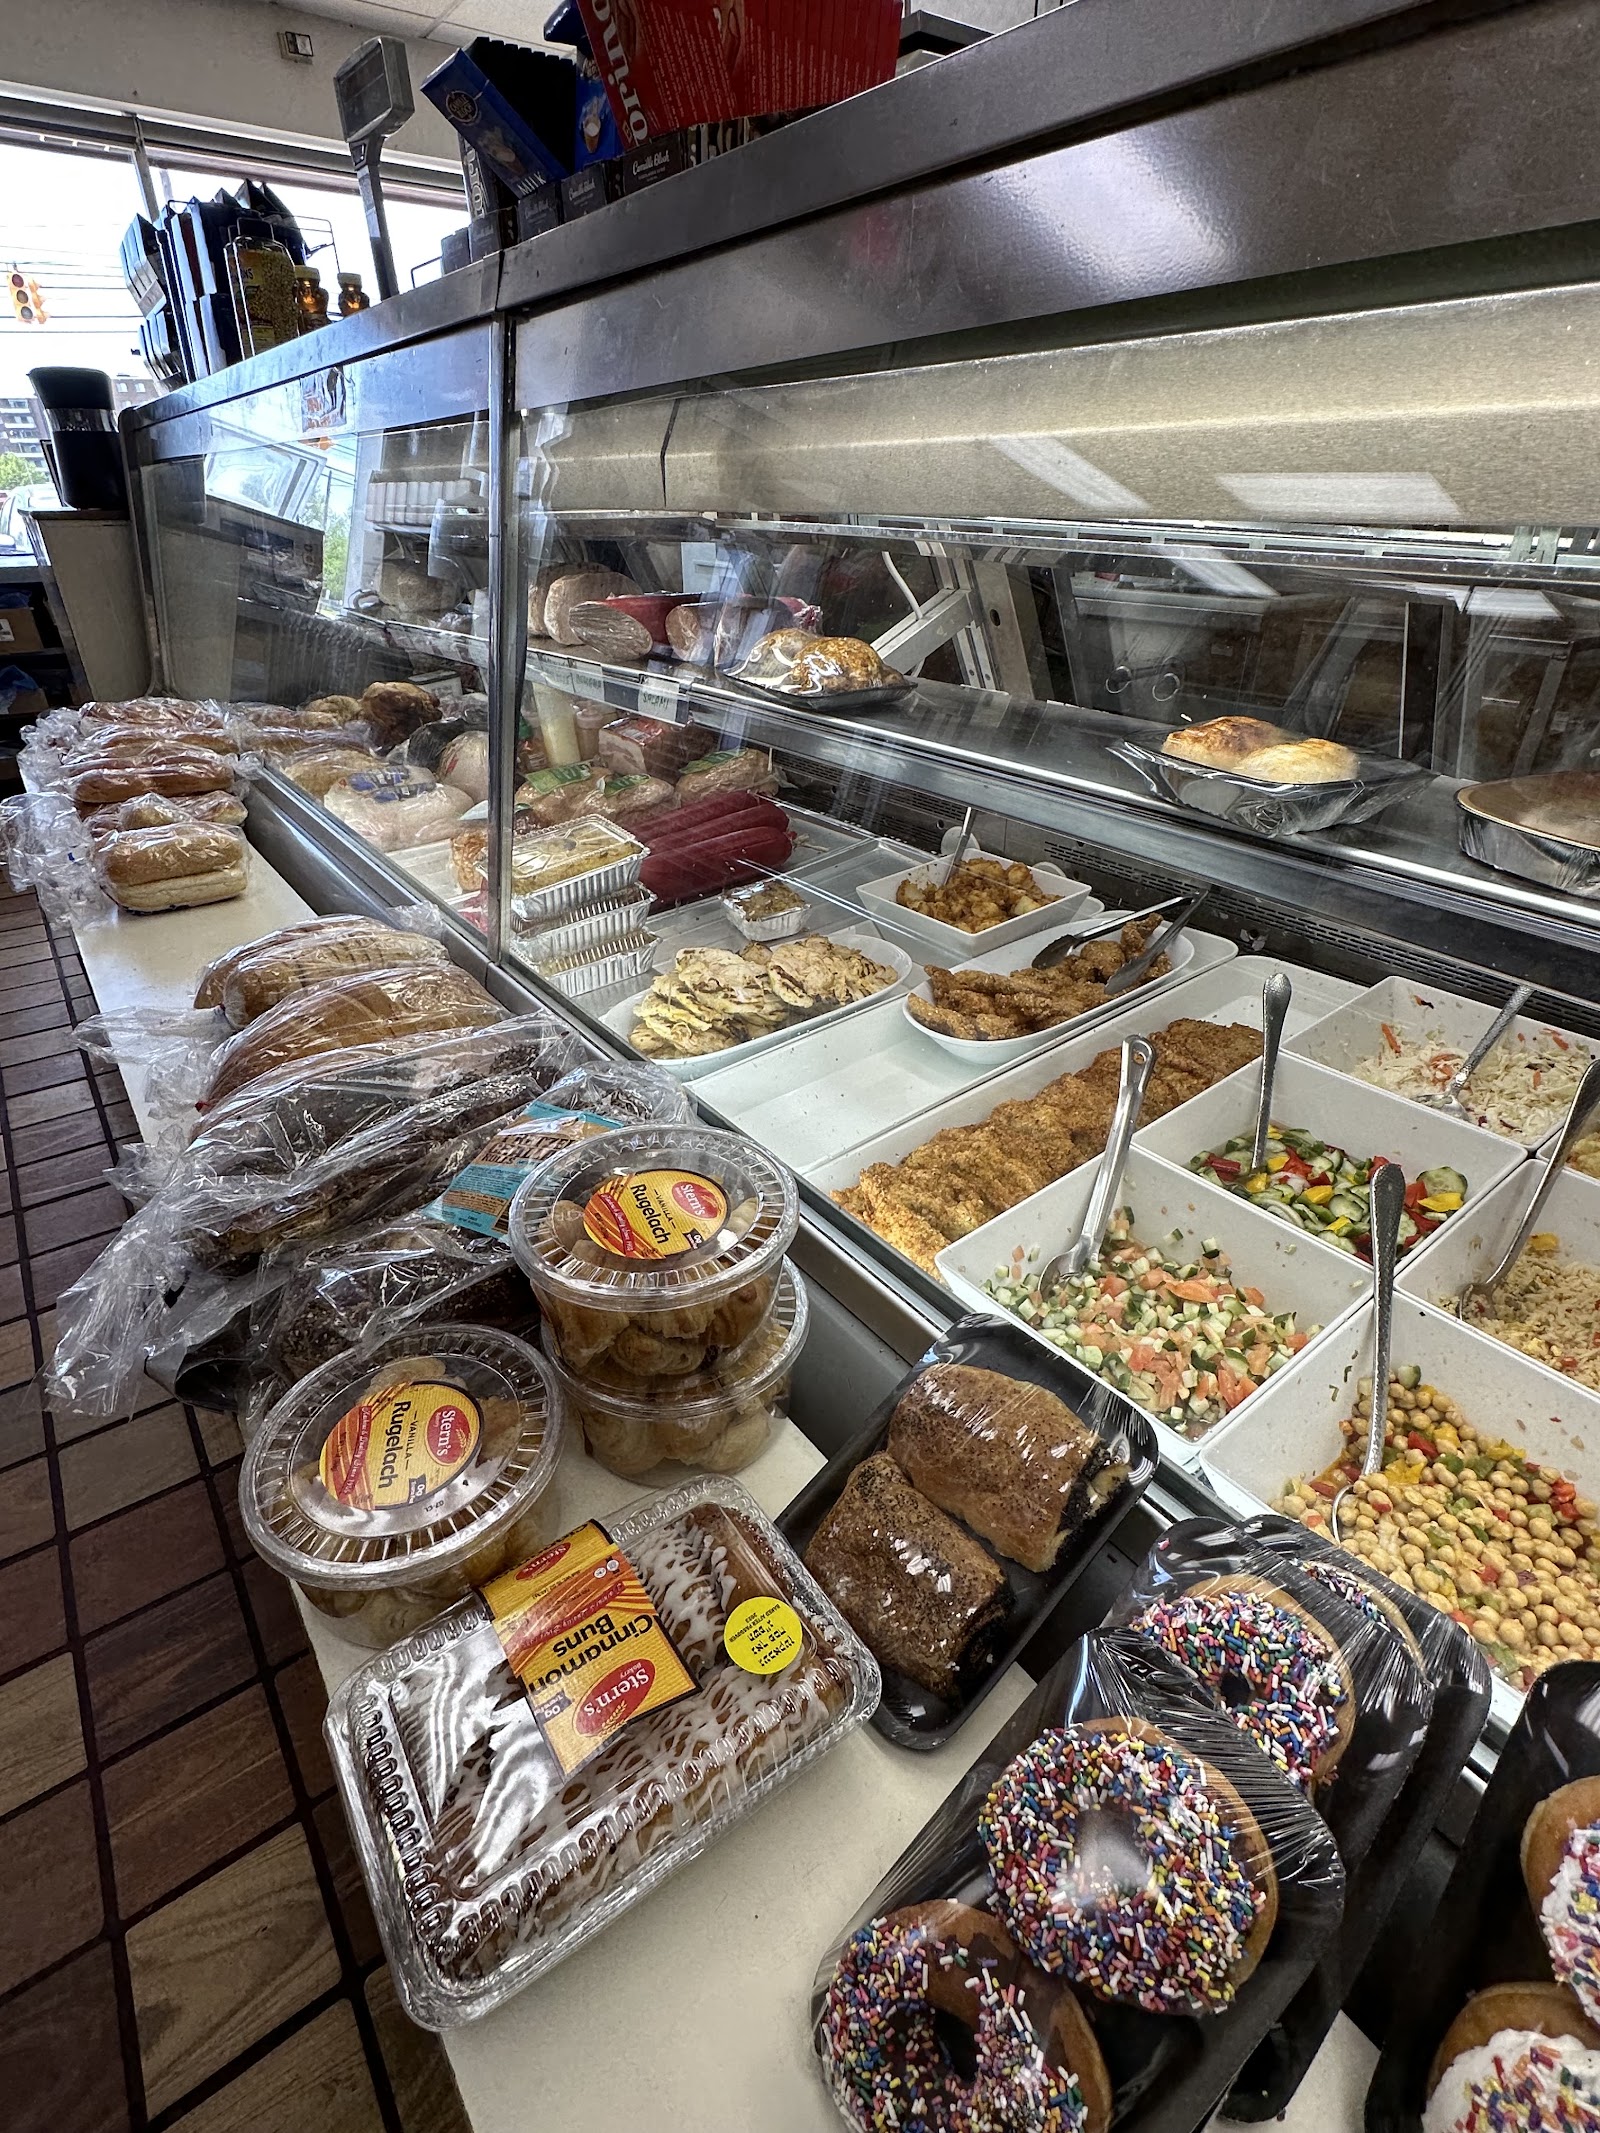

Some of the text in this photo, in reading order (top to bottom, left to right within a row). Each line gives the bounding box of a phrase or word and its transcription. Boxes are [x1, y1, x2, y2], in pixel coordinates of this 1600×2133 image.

[592, 0, 648, 146] orino
[517, 171, 546, 196] MILK
[630, 1183, 671, 1244] Rugelach
[656, 1194, 673, 1222] VANILLA
[681, 1184, 706, 1215] Stern's
[378, 1400, 412, 1489] Rugelach
[404, 1420, 418, 1459] VANILLA
[436, 1409, 456, 1457] Stern's
[553, 1614, 615, 1658] Buns
[752, 1614, 766, 1626] AFTER
[528, 1614, 653, 1696] Cinnamon
[620, 1662, 642, 1679] Bakery
[583, 1668, 649, 1717] Stern's
